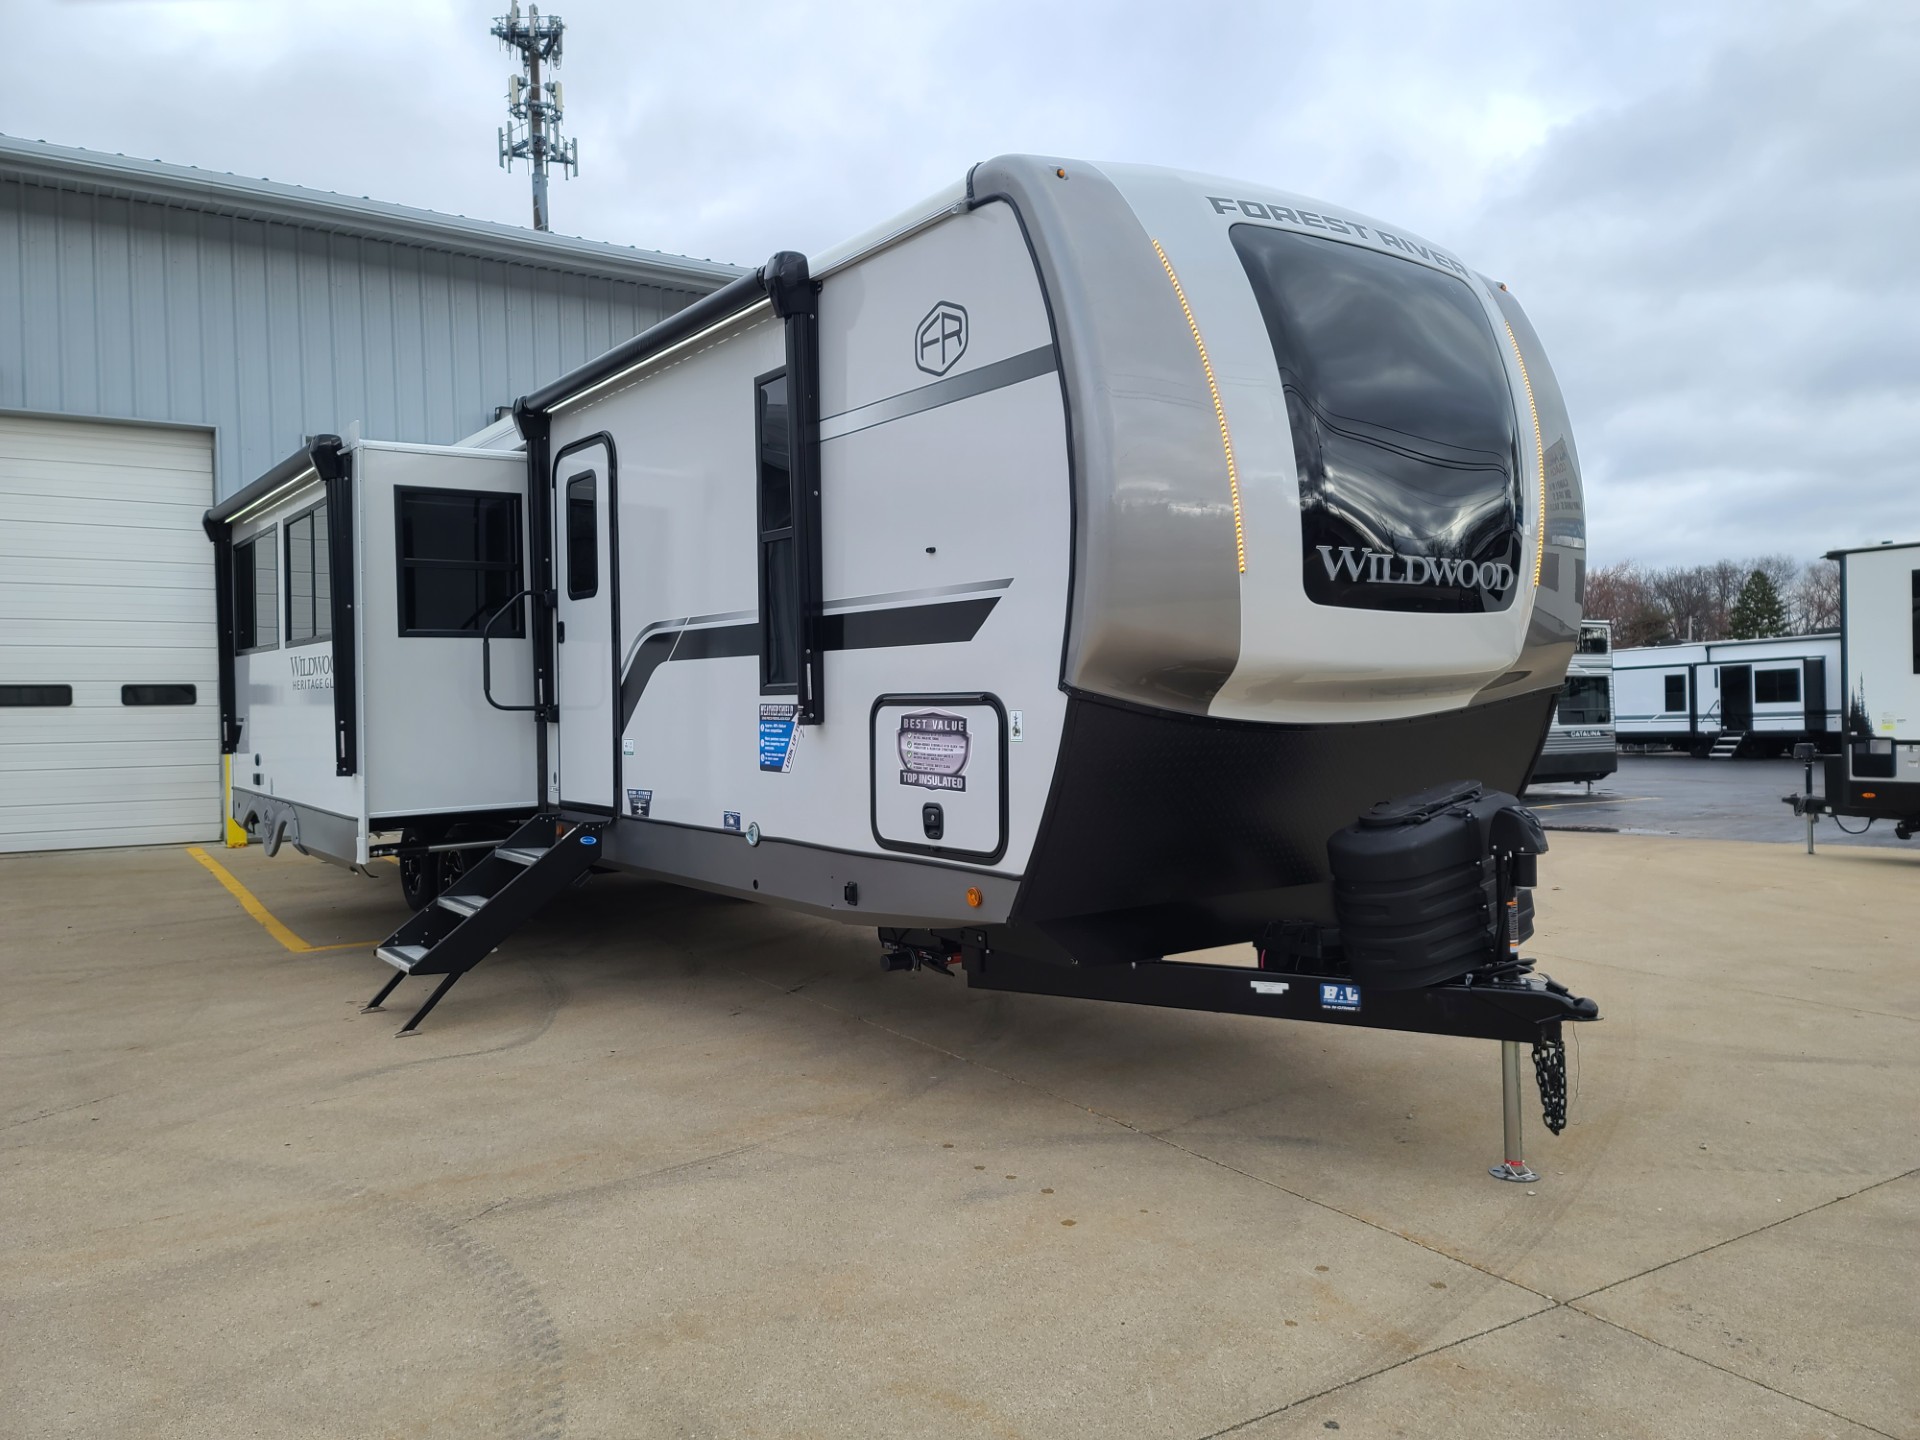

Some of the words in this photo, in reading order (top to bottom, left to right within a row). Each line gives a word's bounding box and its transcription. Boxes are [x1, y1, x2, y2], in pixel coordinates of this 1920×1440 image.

[1206, 196, 1368, 240] FOREST
[1375, 229, 1472, 279] RIVER
[1316, 545, 1514, 591] WILDWOOD
[292, 679, 323, 691] HERITAGE
[903, 718, 927, 729] BEST
[932, 719, 964, 731] VALUE
[903, 772, 917, 784] TOP
[919, 774, 963, 788] INSULATED
